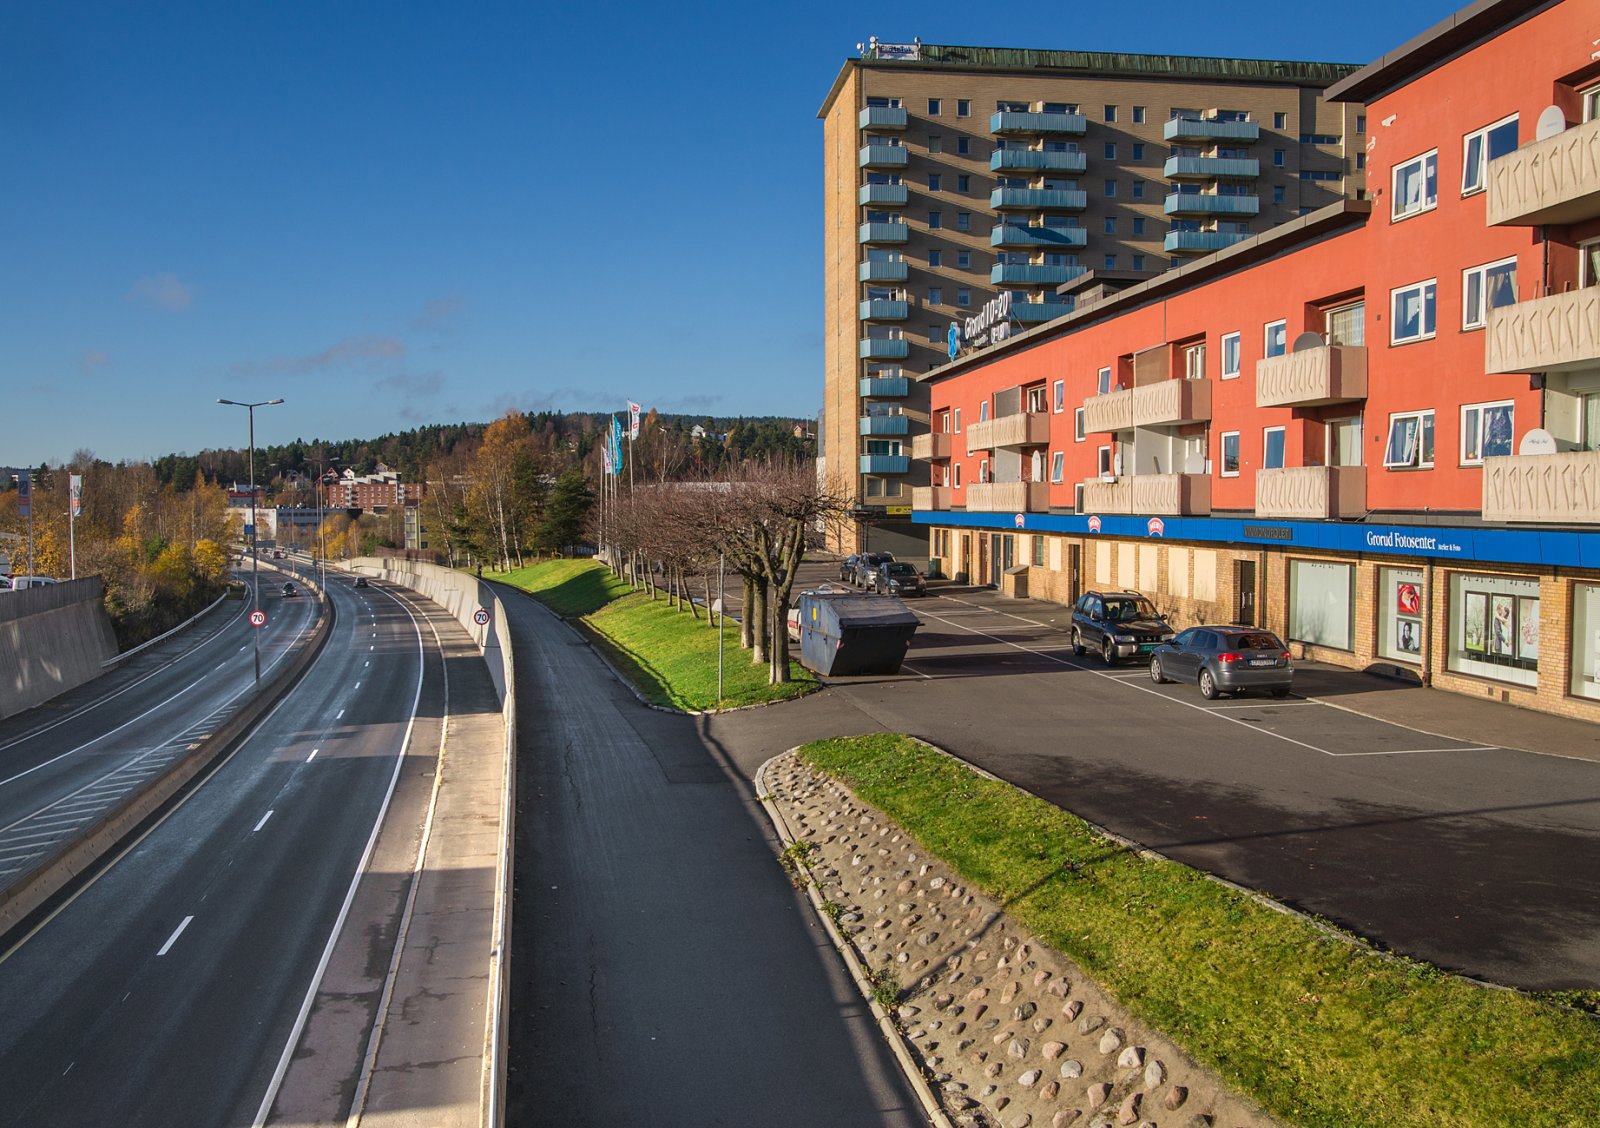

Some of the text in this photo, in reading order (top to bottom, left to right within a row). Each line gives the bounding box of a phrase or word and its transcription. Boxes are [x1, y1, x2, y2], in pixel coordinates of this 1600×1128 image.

[986, 291, 1010, 325] 10-20
[1367, 531, 1393, 547] Grorud
[1394, 532, 1436, 550] Fotosenter
[253, 614, 263, 622] 70
[477, 614, 487, 622] 70
